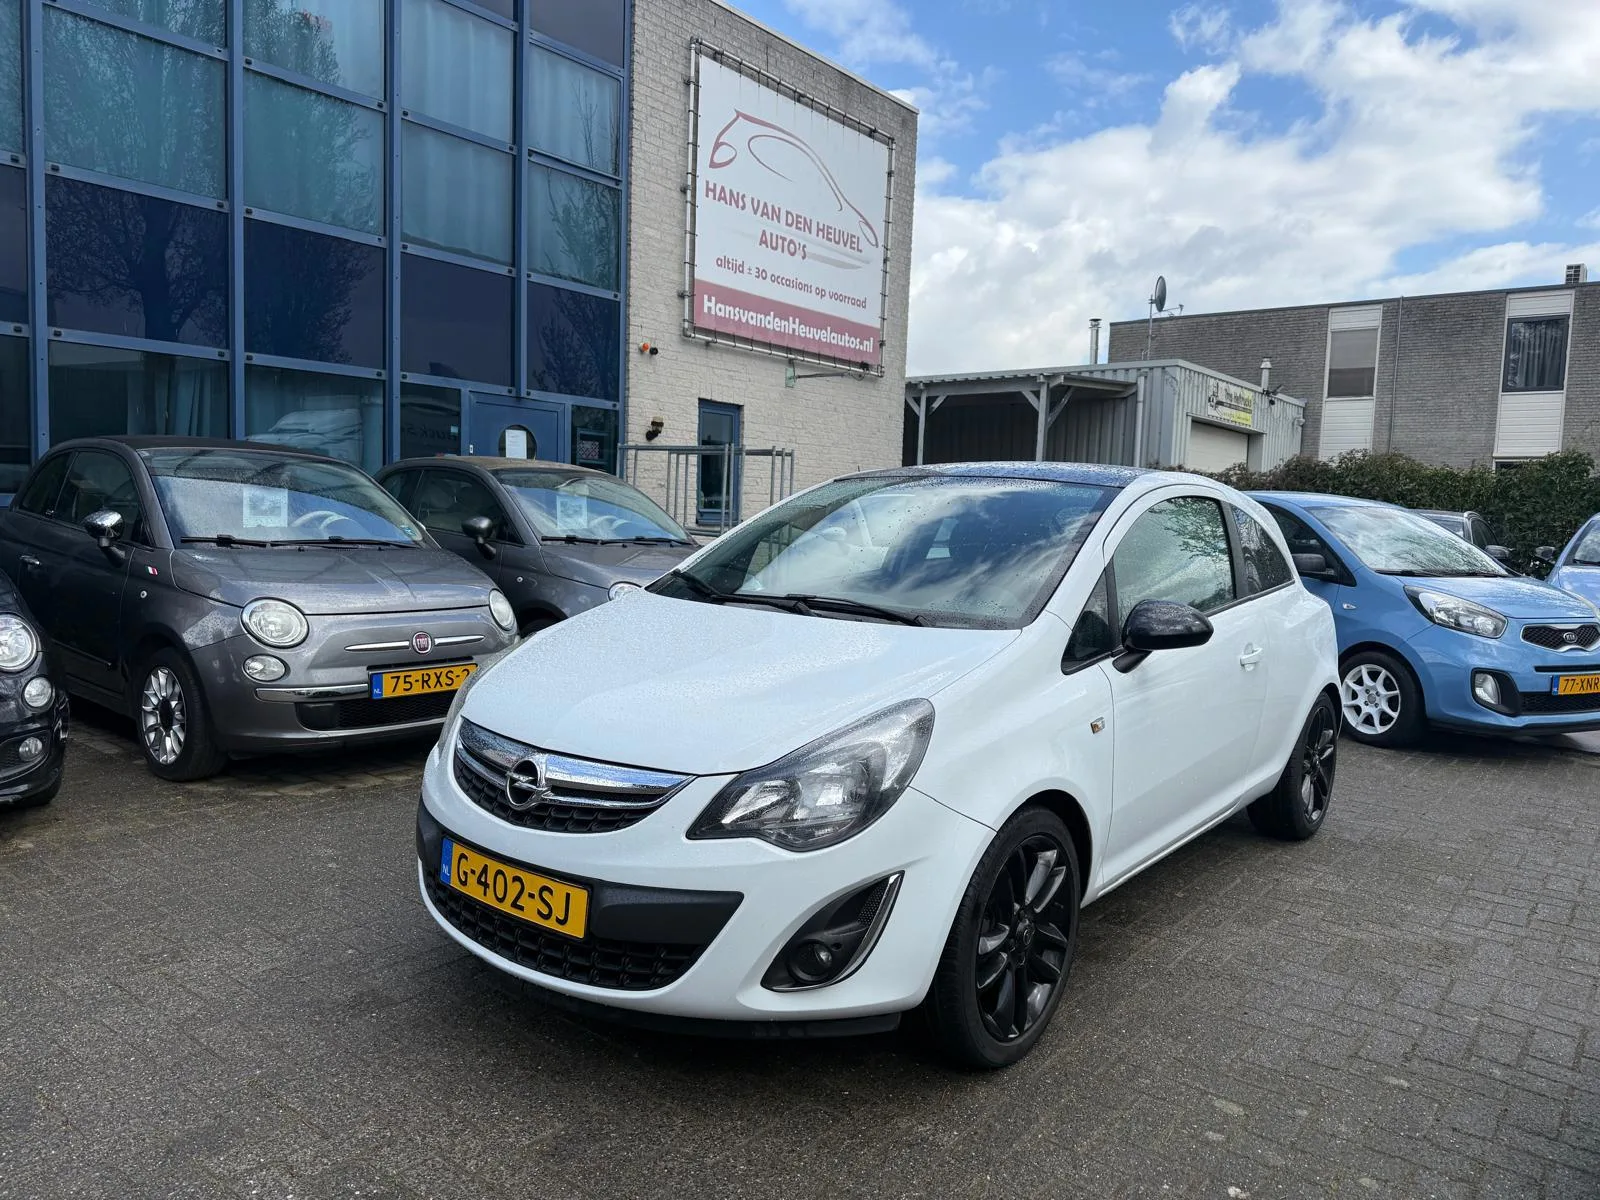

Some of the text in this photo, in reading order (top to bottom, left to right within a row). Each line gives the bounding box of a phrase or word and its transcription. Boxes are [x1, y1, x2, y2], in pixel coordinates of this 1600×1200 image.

[705, 180, 862, 253] HANS VAN DEN HEUVEL
[759, 229, 807, 260] AUTO'S
[716, 256, 744, 274] altijd
[755, 267, 767, 280] 30
[770, 272, 812, 294] occasions
[815, 286, 826, 298] op
[829, 290, 867, 309] voorraad
[703, 294, 873, 353] HansvandenHeuvelautos.nl
[442, 863, 450, 876] NL
[456, 852, 571, 926] G-402-SJ
